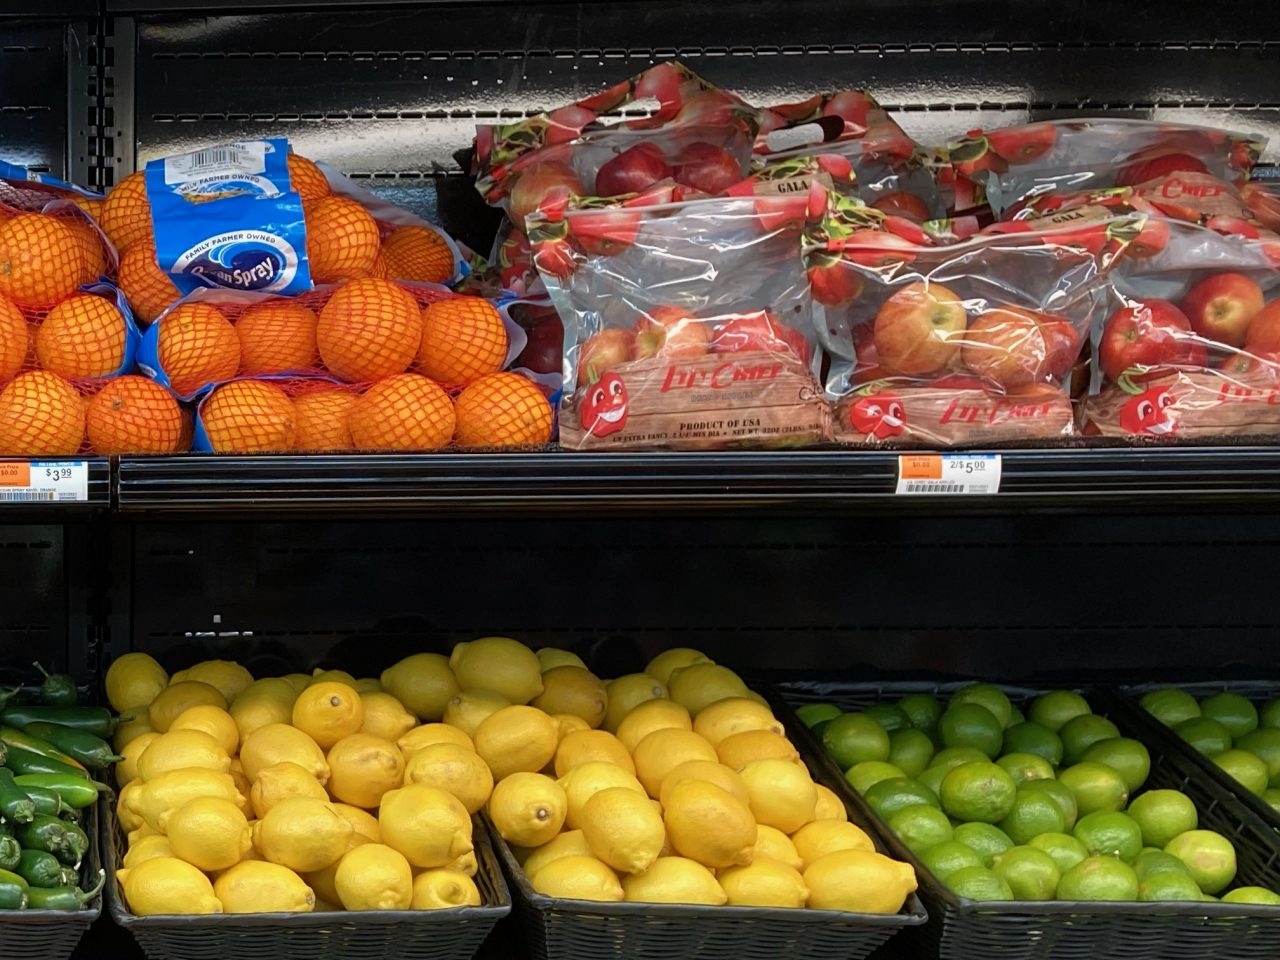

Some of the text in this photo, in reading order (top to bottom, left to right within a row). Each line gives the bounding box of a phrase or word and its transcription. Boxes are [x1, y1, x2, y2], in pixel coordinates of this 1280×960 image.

[777, 179, 809, 194] GALA
[1052, 211, 1085, 224] GALA
[184, 233, 276, 261] FAMILY FARMER OWNED
[233, 256, 274, 287] Spray
[679, 418, 761, 431] PRODUCT OF USA
